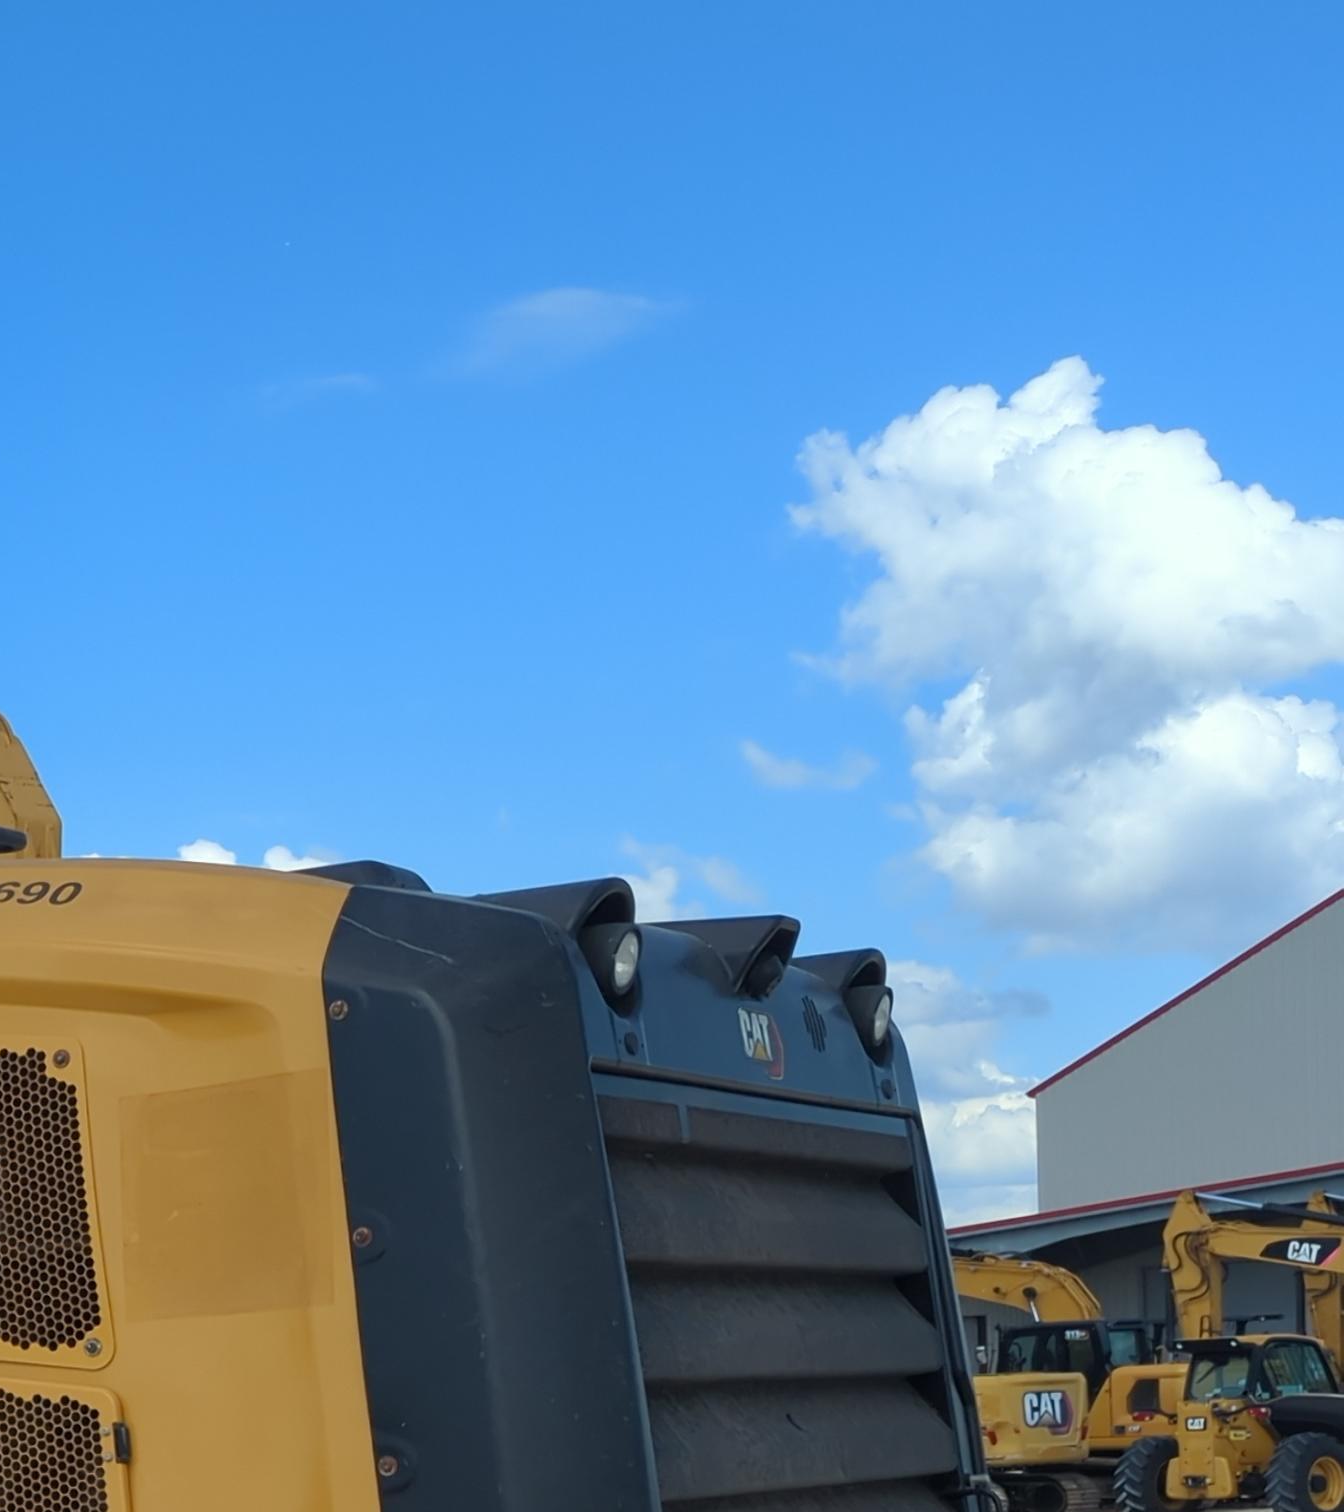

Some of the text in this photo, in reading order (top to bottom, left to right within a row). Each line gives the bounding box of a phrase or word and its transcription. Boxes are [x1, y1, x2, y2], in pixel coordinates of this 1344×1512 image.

[737, 1007, 773, 1062] CAT
[1287, 1241, 1321, 1264] CAT
[1023, 1392, 1063, 1426] CAT
